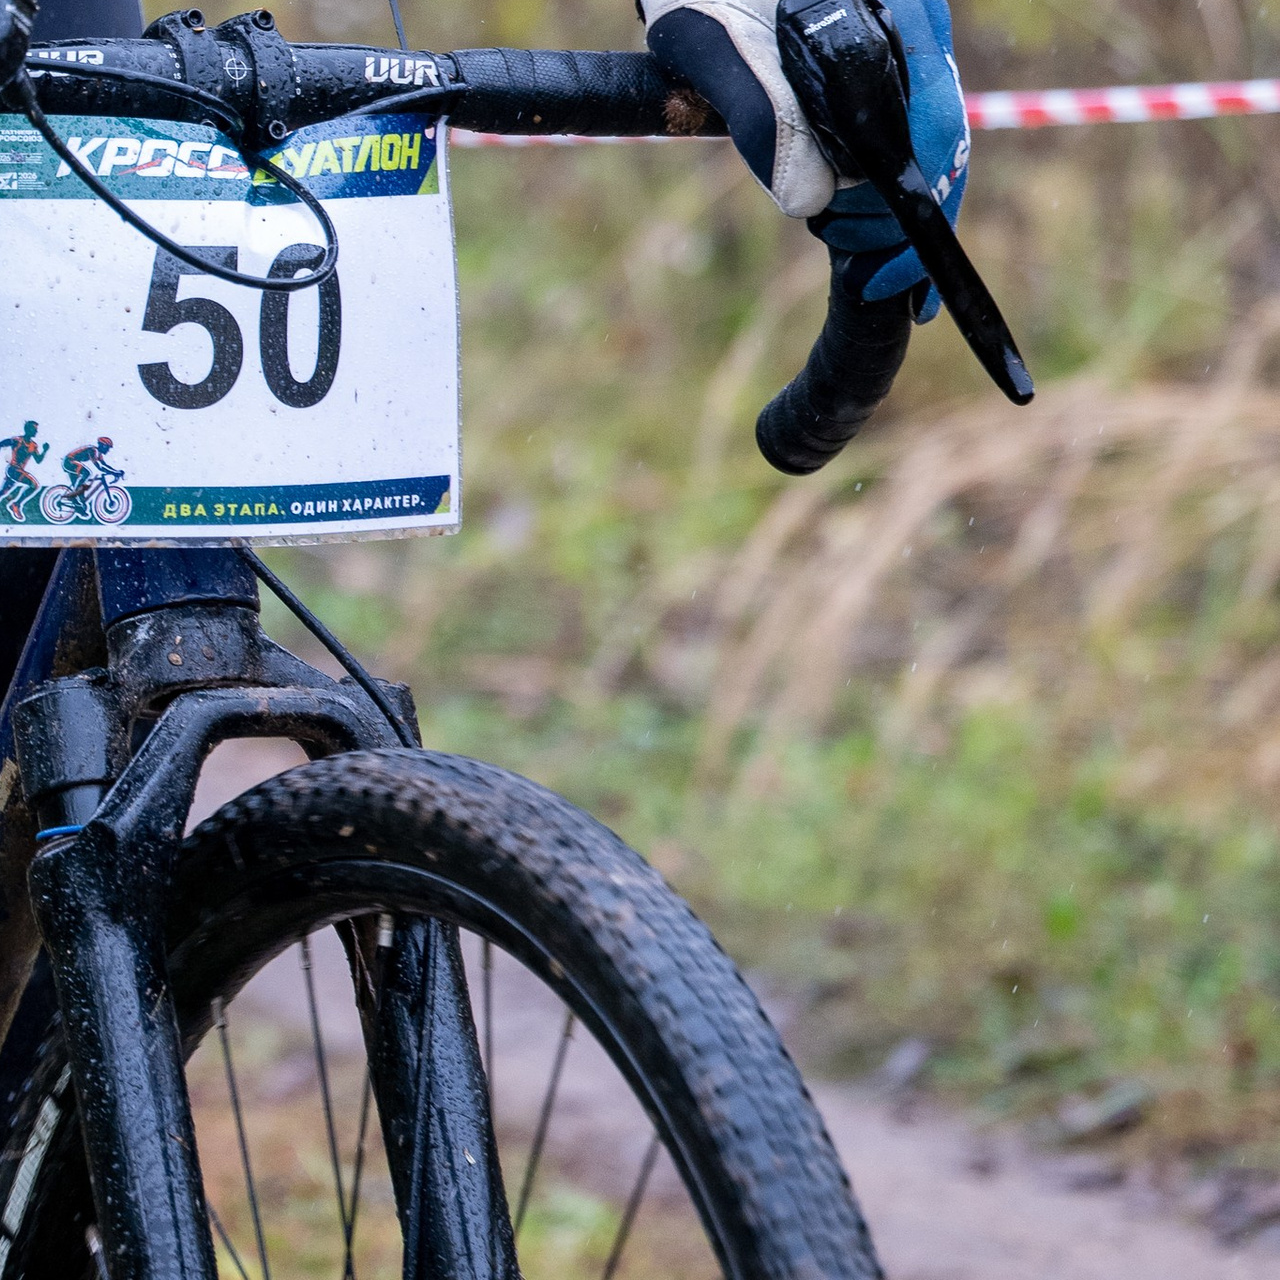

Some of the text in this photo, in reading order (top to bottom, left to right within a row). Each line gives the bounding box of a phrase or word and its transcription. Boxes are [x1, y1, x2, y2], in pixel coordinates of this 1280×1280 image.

[803, 8, 848, 36] microSHIFT
[18, 172, 38, 180] 2026
[137, 242, 342, 410] 50
[162, 494, 426, 518] ДВА ЭТАПА. ОДИН ХАРАКТЕР.
